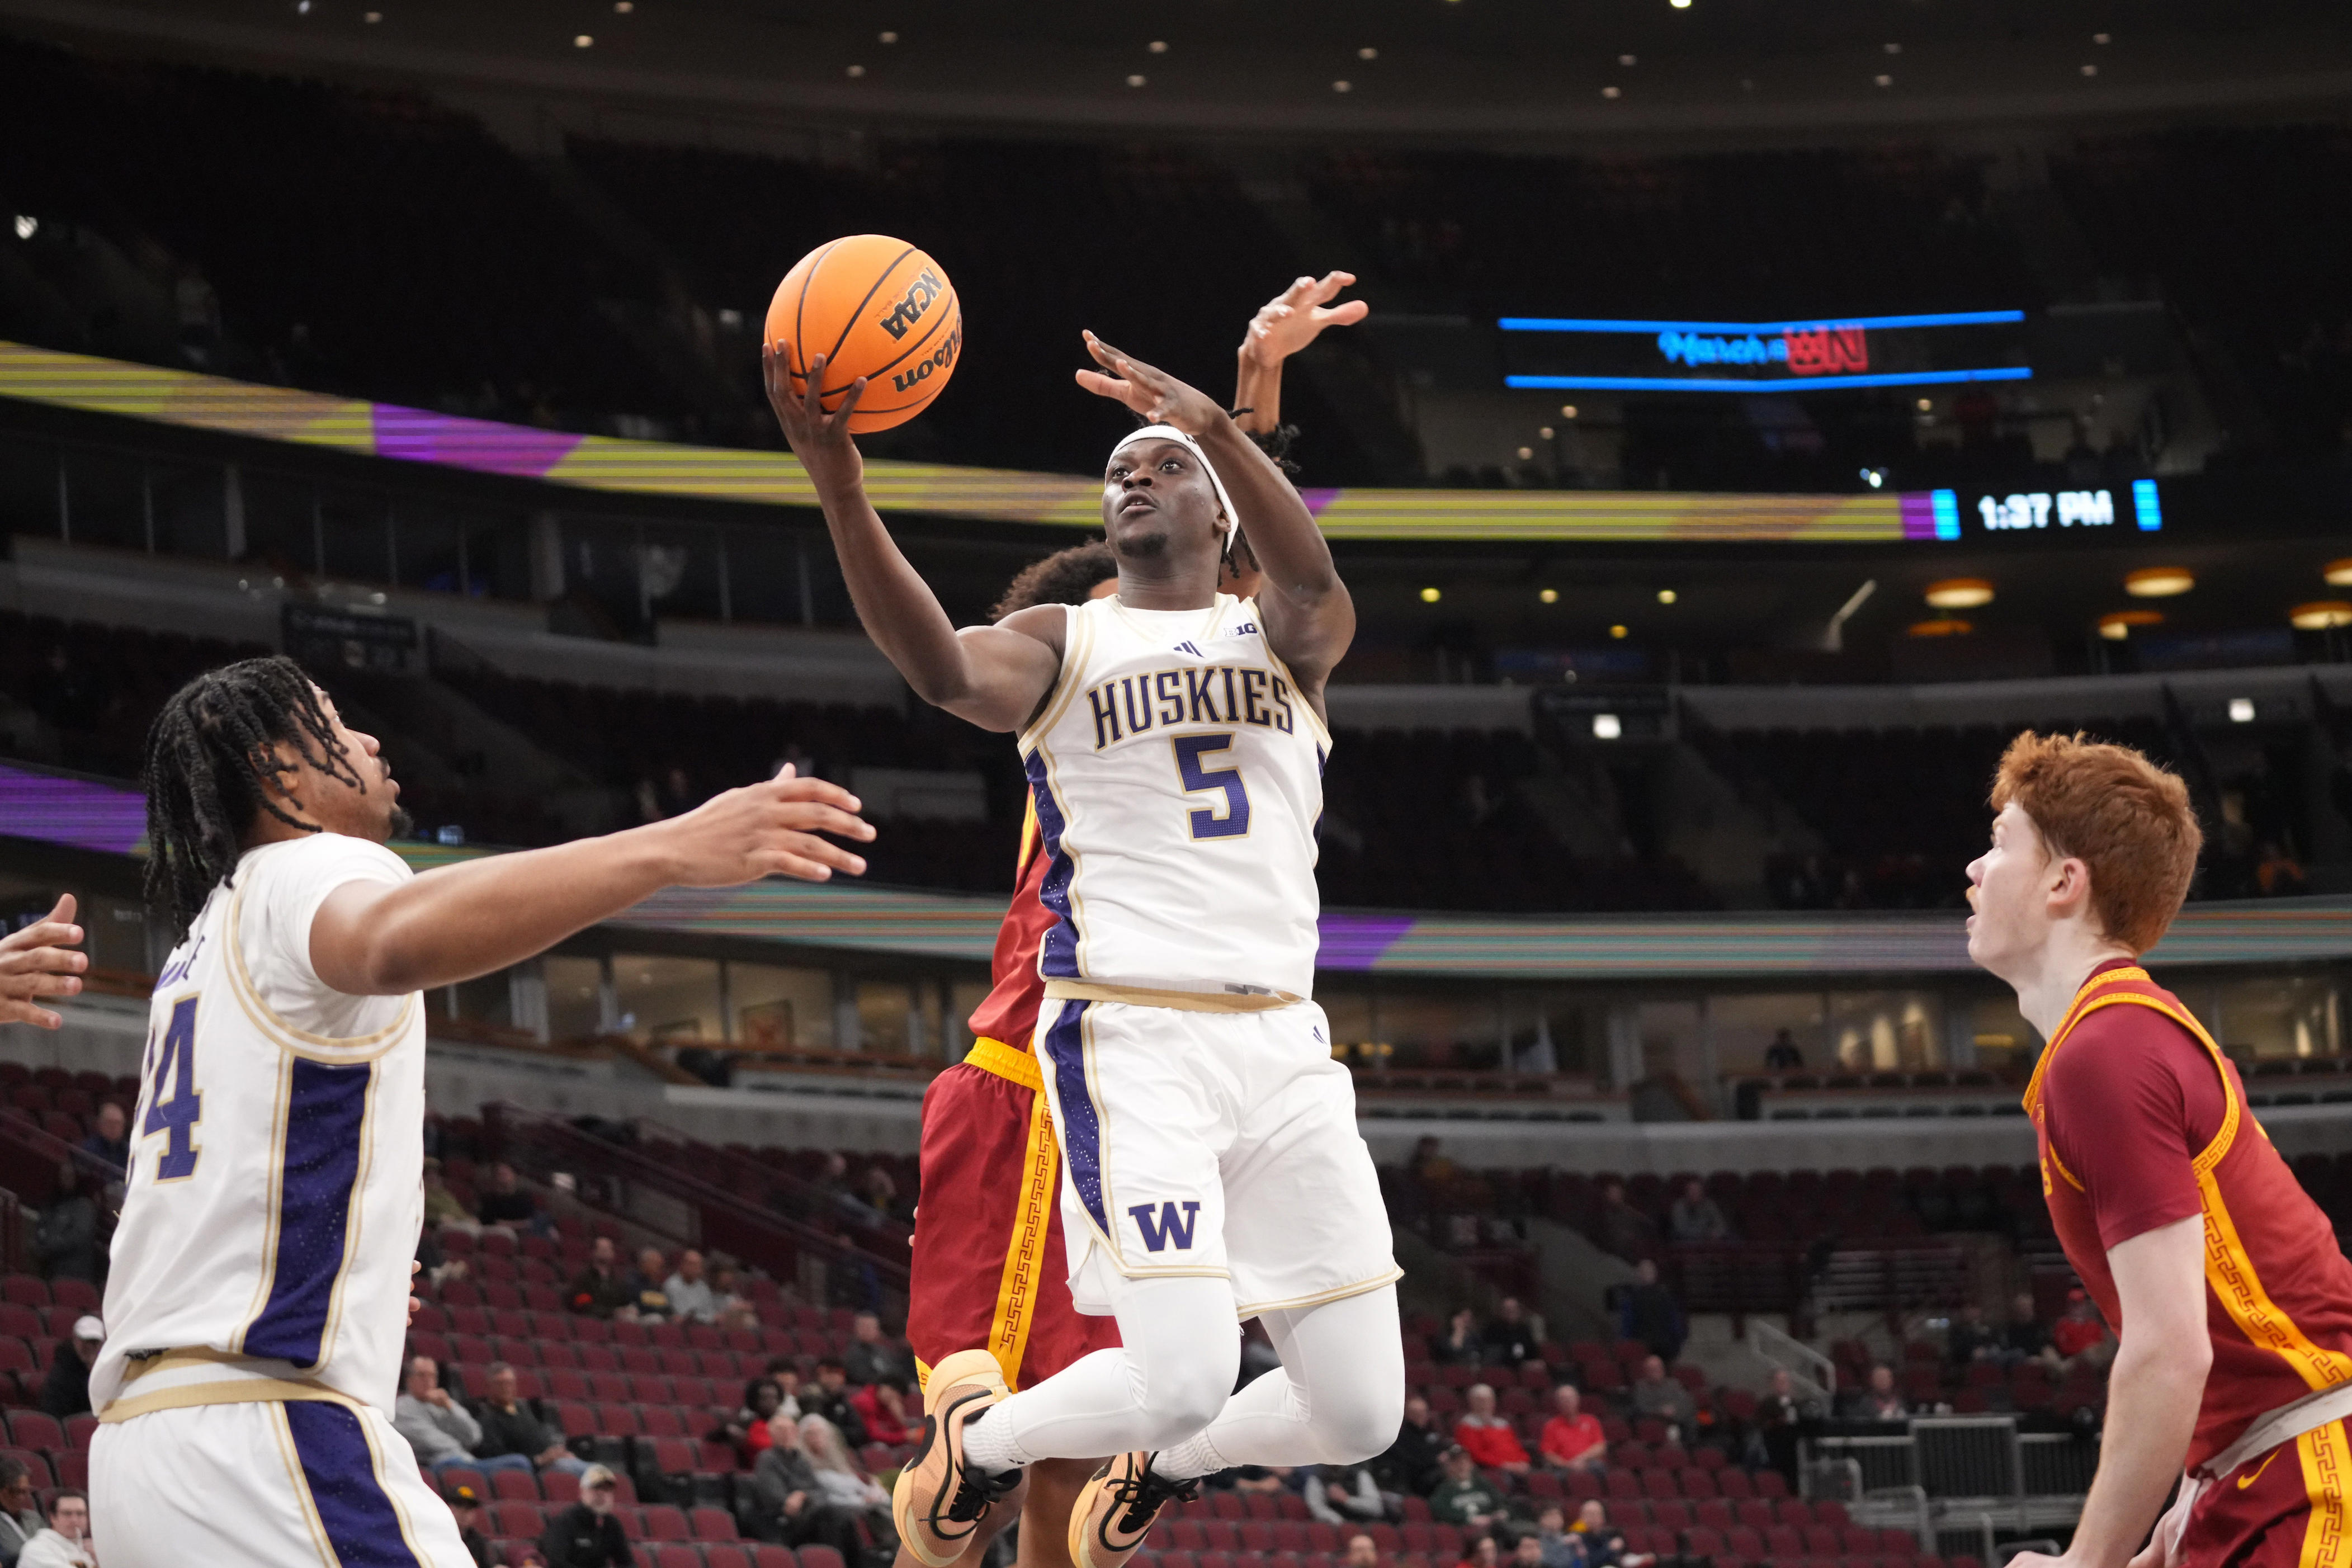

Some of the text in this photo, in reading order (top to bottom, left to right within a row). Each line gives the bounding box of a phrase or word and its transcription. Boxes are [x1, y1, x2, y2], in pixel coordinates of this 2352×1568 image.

[879, 266, 943, 341] NCAA
[1978, 490, 2114, 530] 1:37 PM
[1087, 665, 1295, 753] HUSKIES
[1170, 731, 1253, 842] 5
[129, 991, 204, 1192] 4
[1127, 1201, 1201, 1253] W
